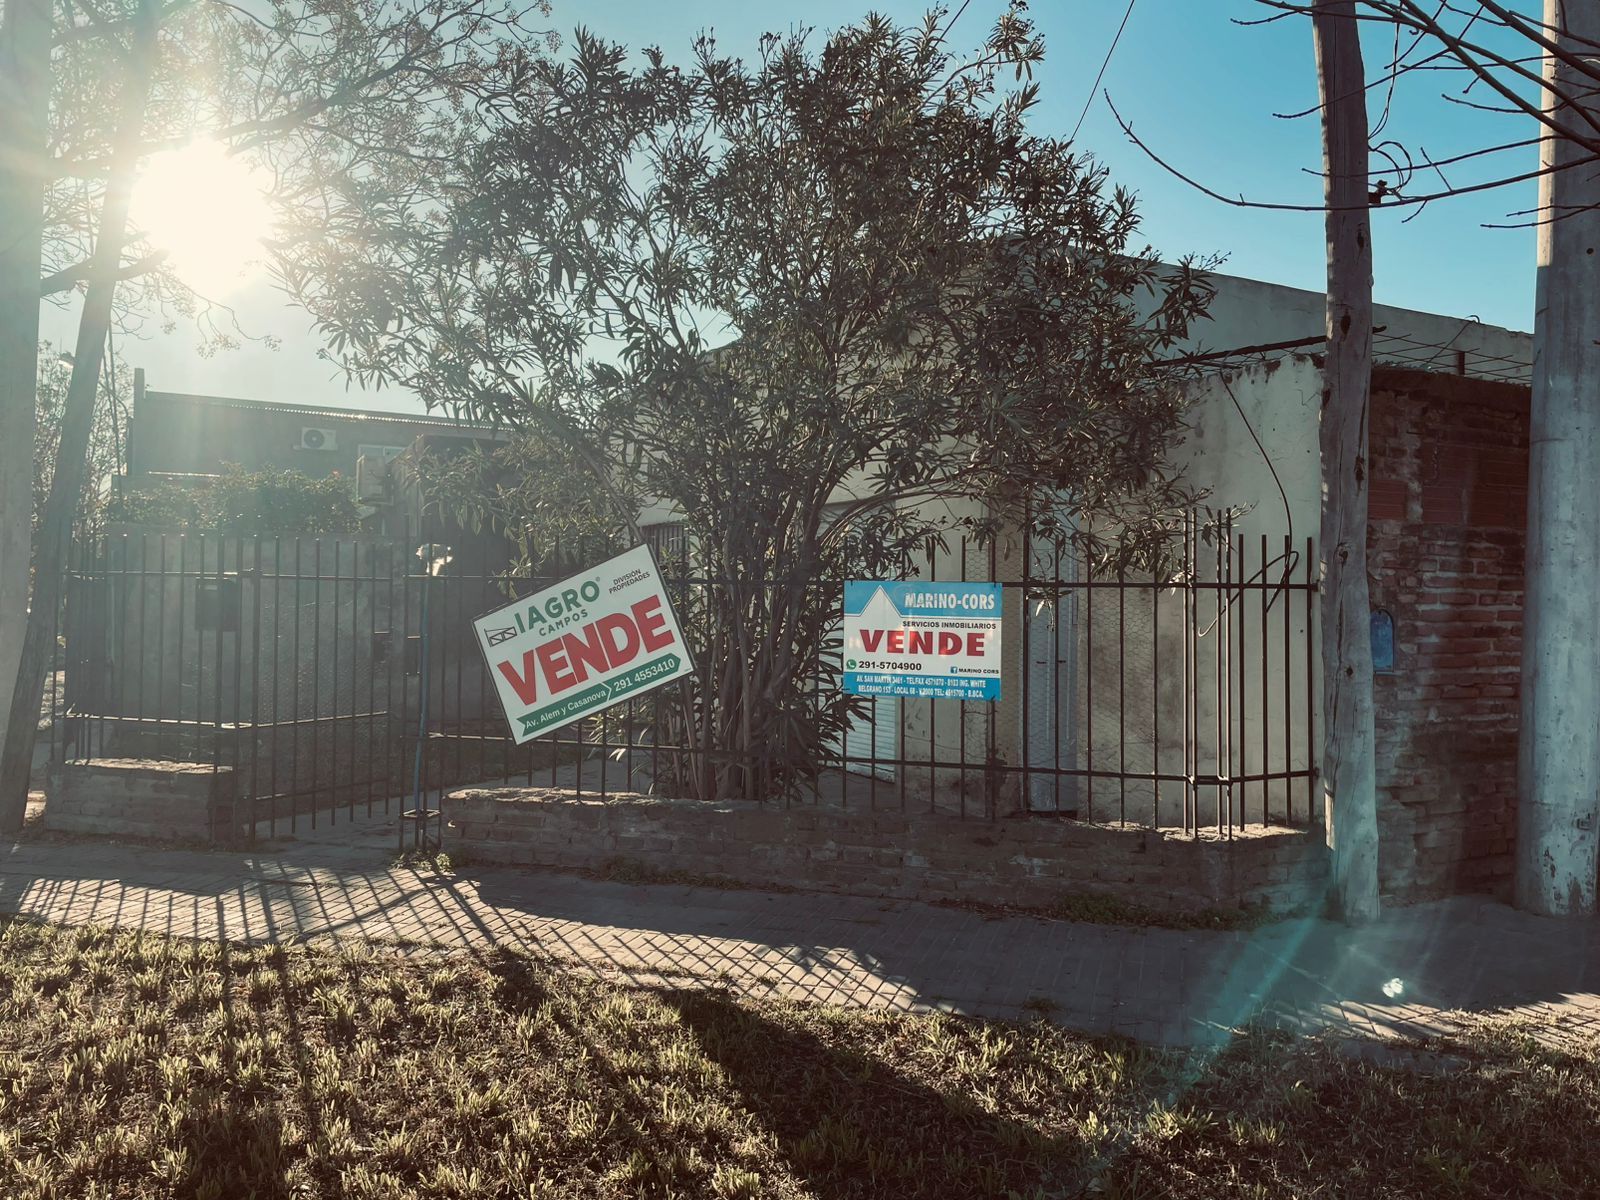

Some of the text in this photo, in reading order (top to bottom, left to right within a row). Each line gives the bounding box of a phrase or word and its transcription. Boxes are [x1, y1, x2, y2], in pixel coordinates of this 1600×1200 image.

[608, 572, 650, 594] PROPIEDADES
[613, 569, 641, 586] DIVISIÓN
[514, 581, 600, 633] IAGRO
[904, 592, 995, 610] MARINO-CORS
[539, 609, 588, 637] CAMPOS
[902, 620, 996, 630] SERVICIOS INMOBILIARIOS
[497, 594, 675, 706] VENDE
[859, 629, 985, 657] VENDE
[613, 658, 675, 692] 291 4553410
[858, 660, 922, 671] 291-5704900
[894, 686, 908, 694] LOCAL
[525, 716, 539, 729] Av.
[540, 709, 560, 723] Alem
[567, 690, 607, 712] Casanova
